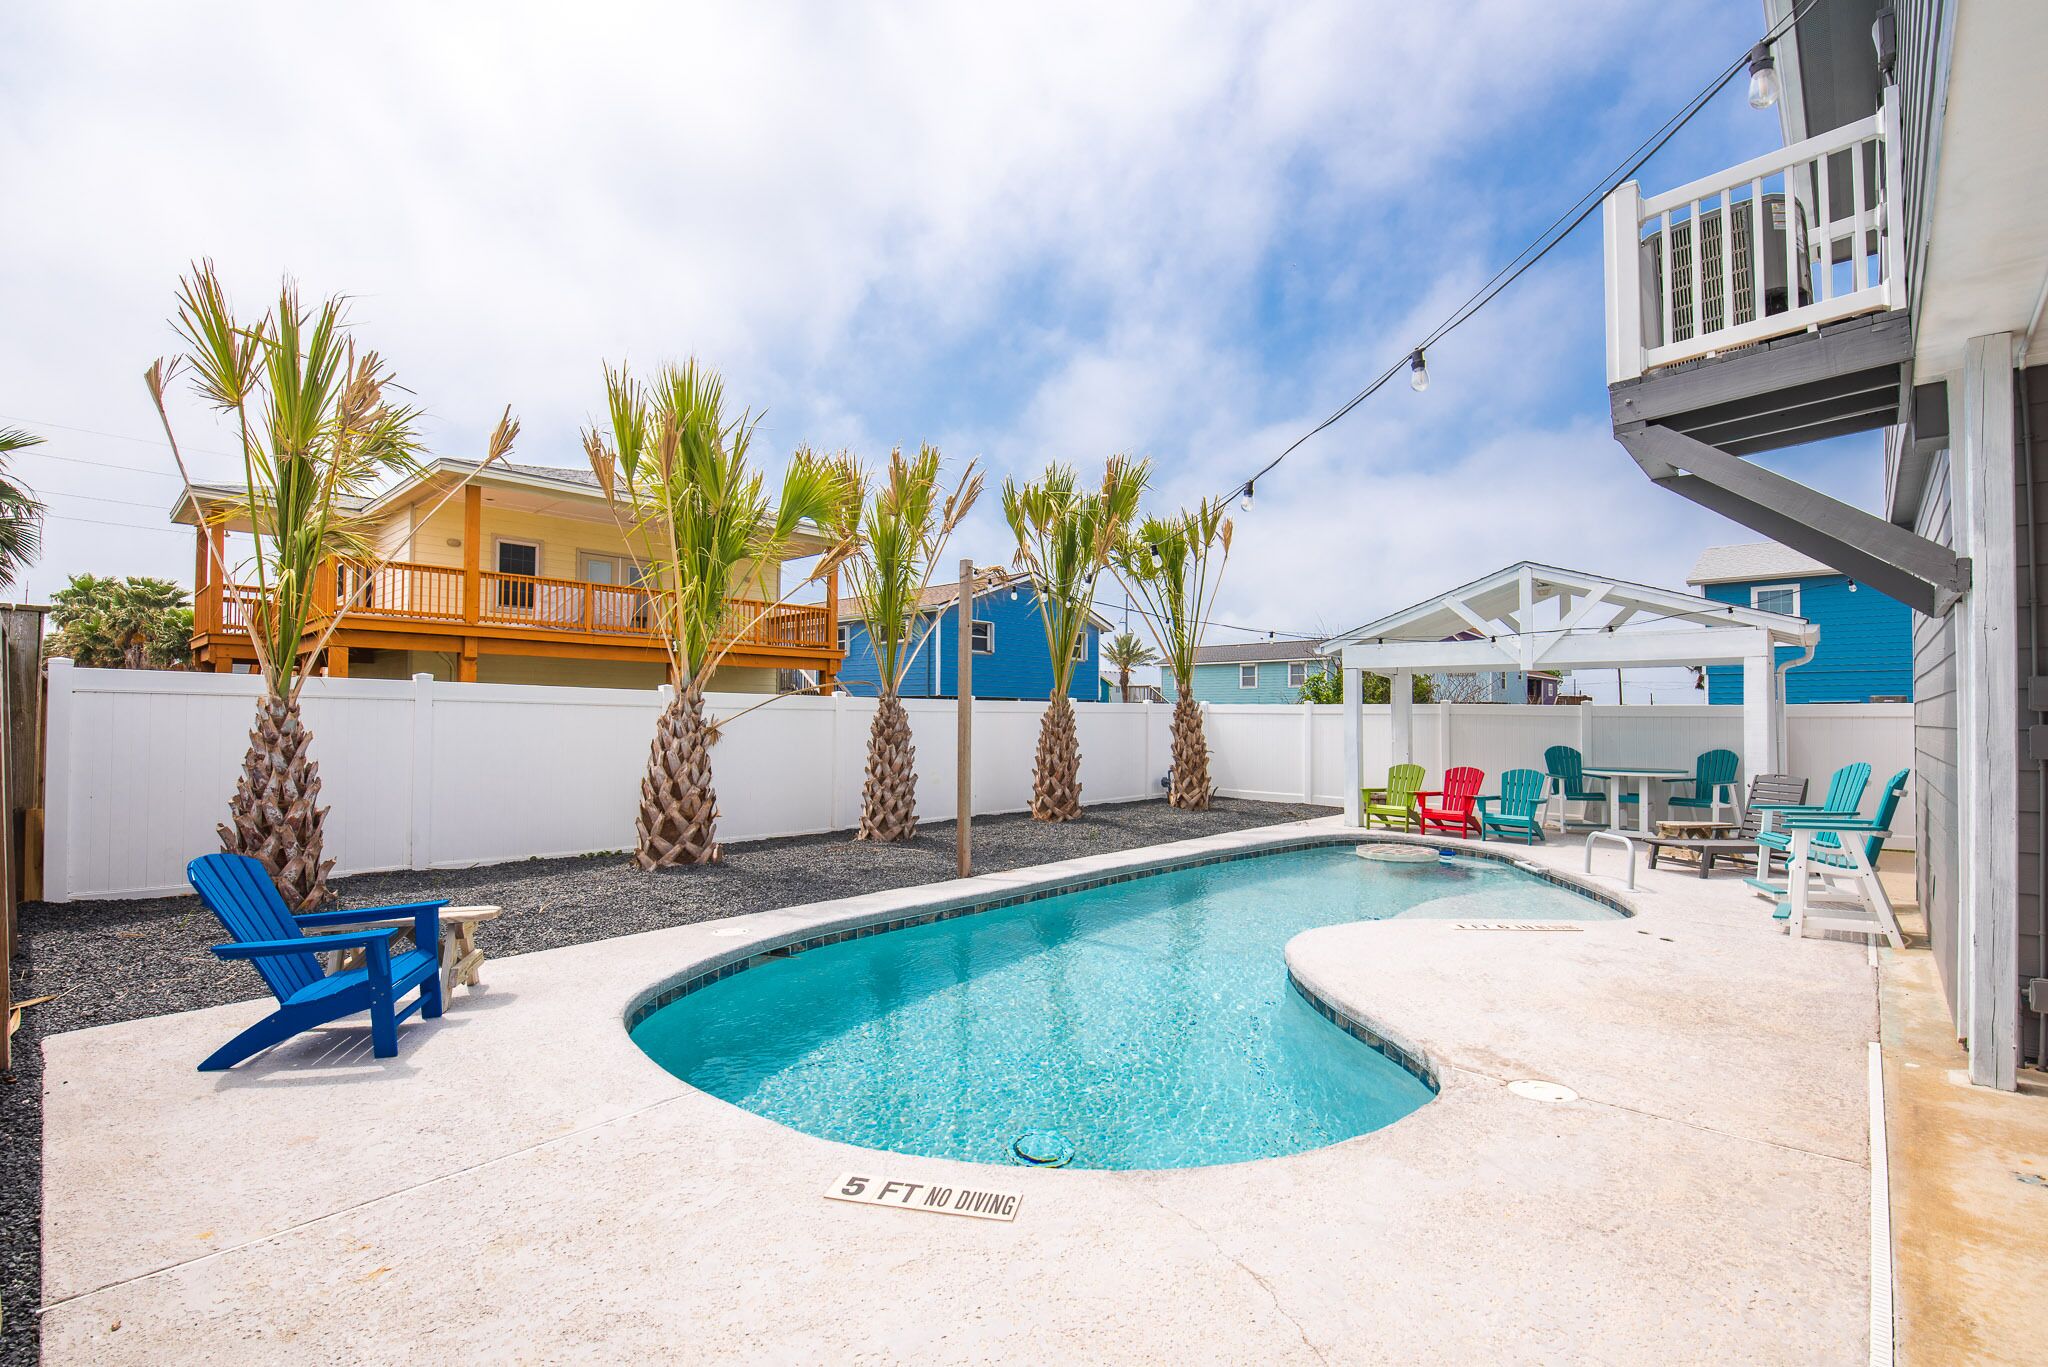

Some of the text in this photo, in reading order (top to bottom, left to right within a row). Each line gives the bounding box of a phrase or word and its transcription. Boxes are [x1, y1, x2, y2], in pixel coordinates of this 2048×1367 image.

[841, 1176, 1016, 1216] 5 FT NO DIVING
